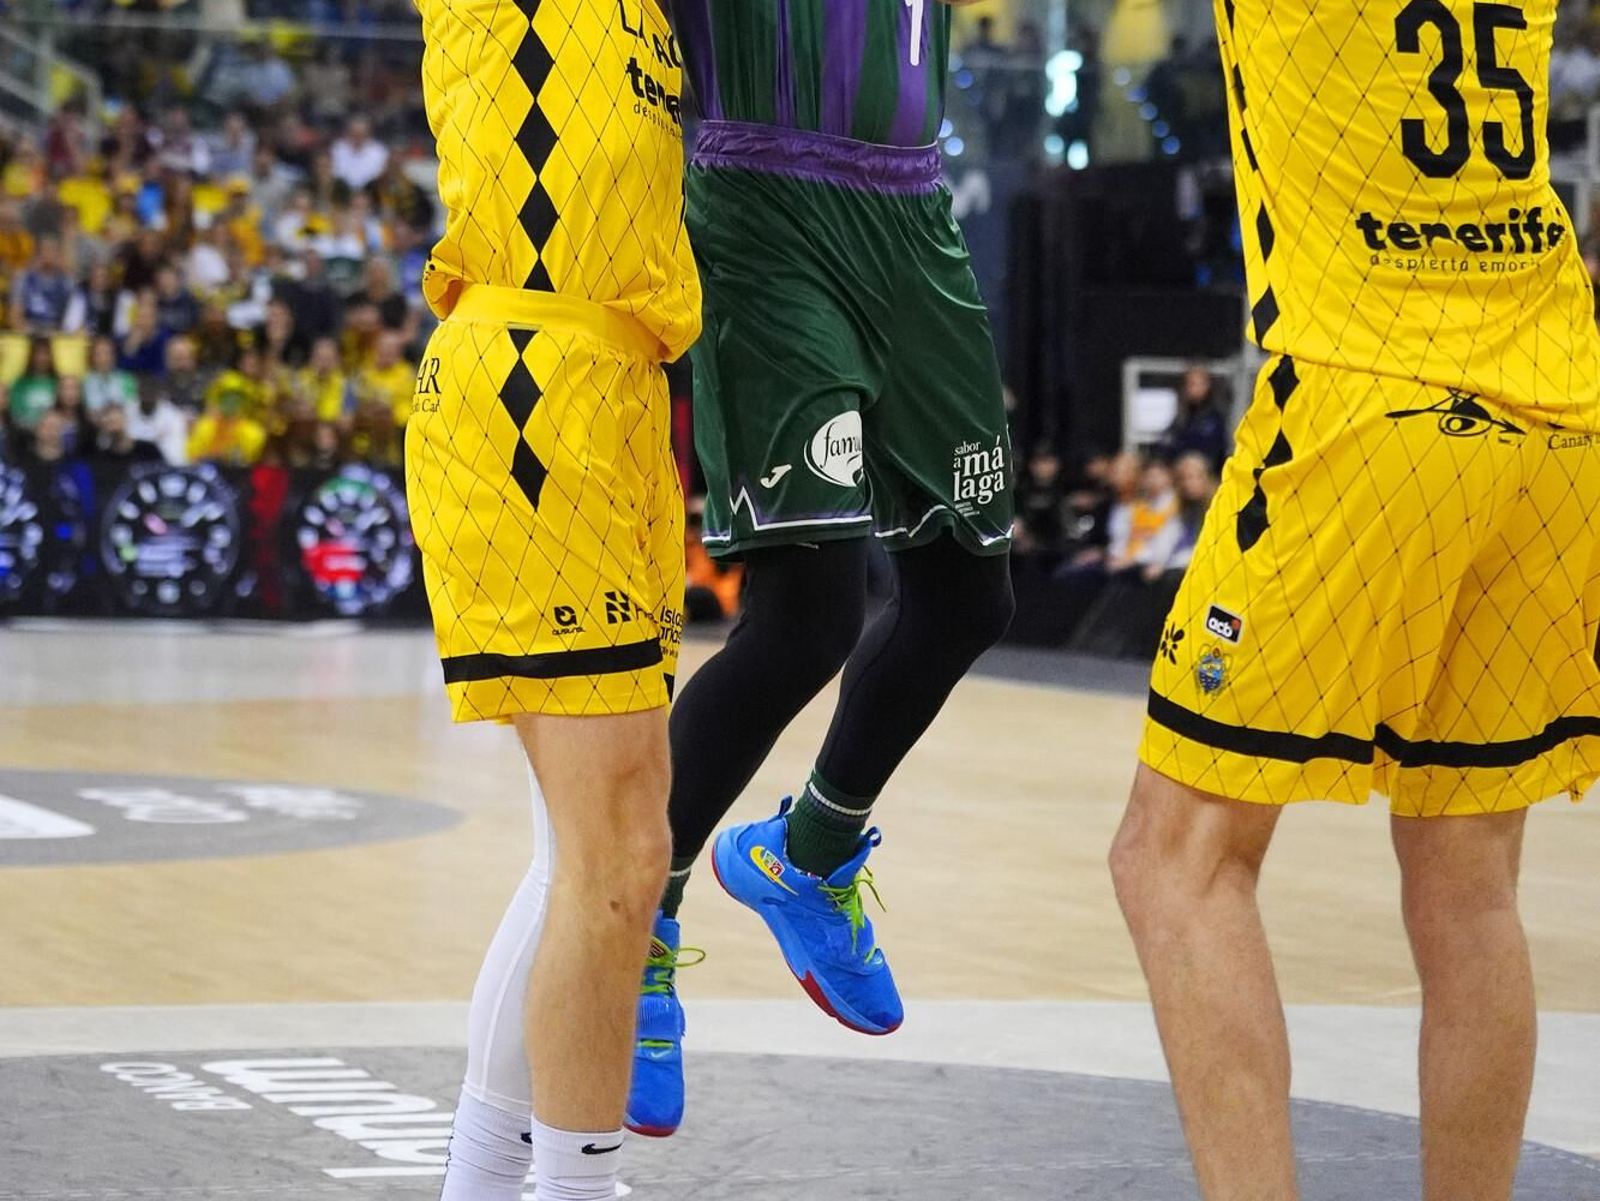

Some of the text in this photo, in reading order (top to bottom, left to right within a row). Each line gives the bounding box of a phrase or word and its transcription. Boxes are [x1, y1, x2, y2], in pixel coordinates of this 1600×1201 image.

[953, 440, 981, 456] sabor
[962, 434, 1005, 478] má
[953, 470, 1005, 505] laga
[1208, 616, 1233, 638] acb
[100, 1062, 253, 1111] BANCO
